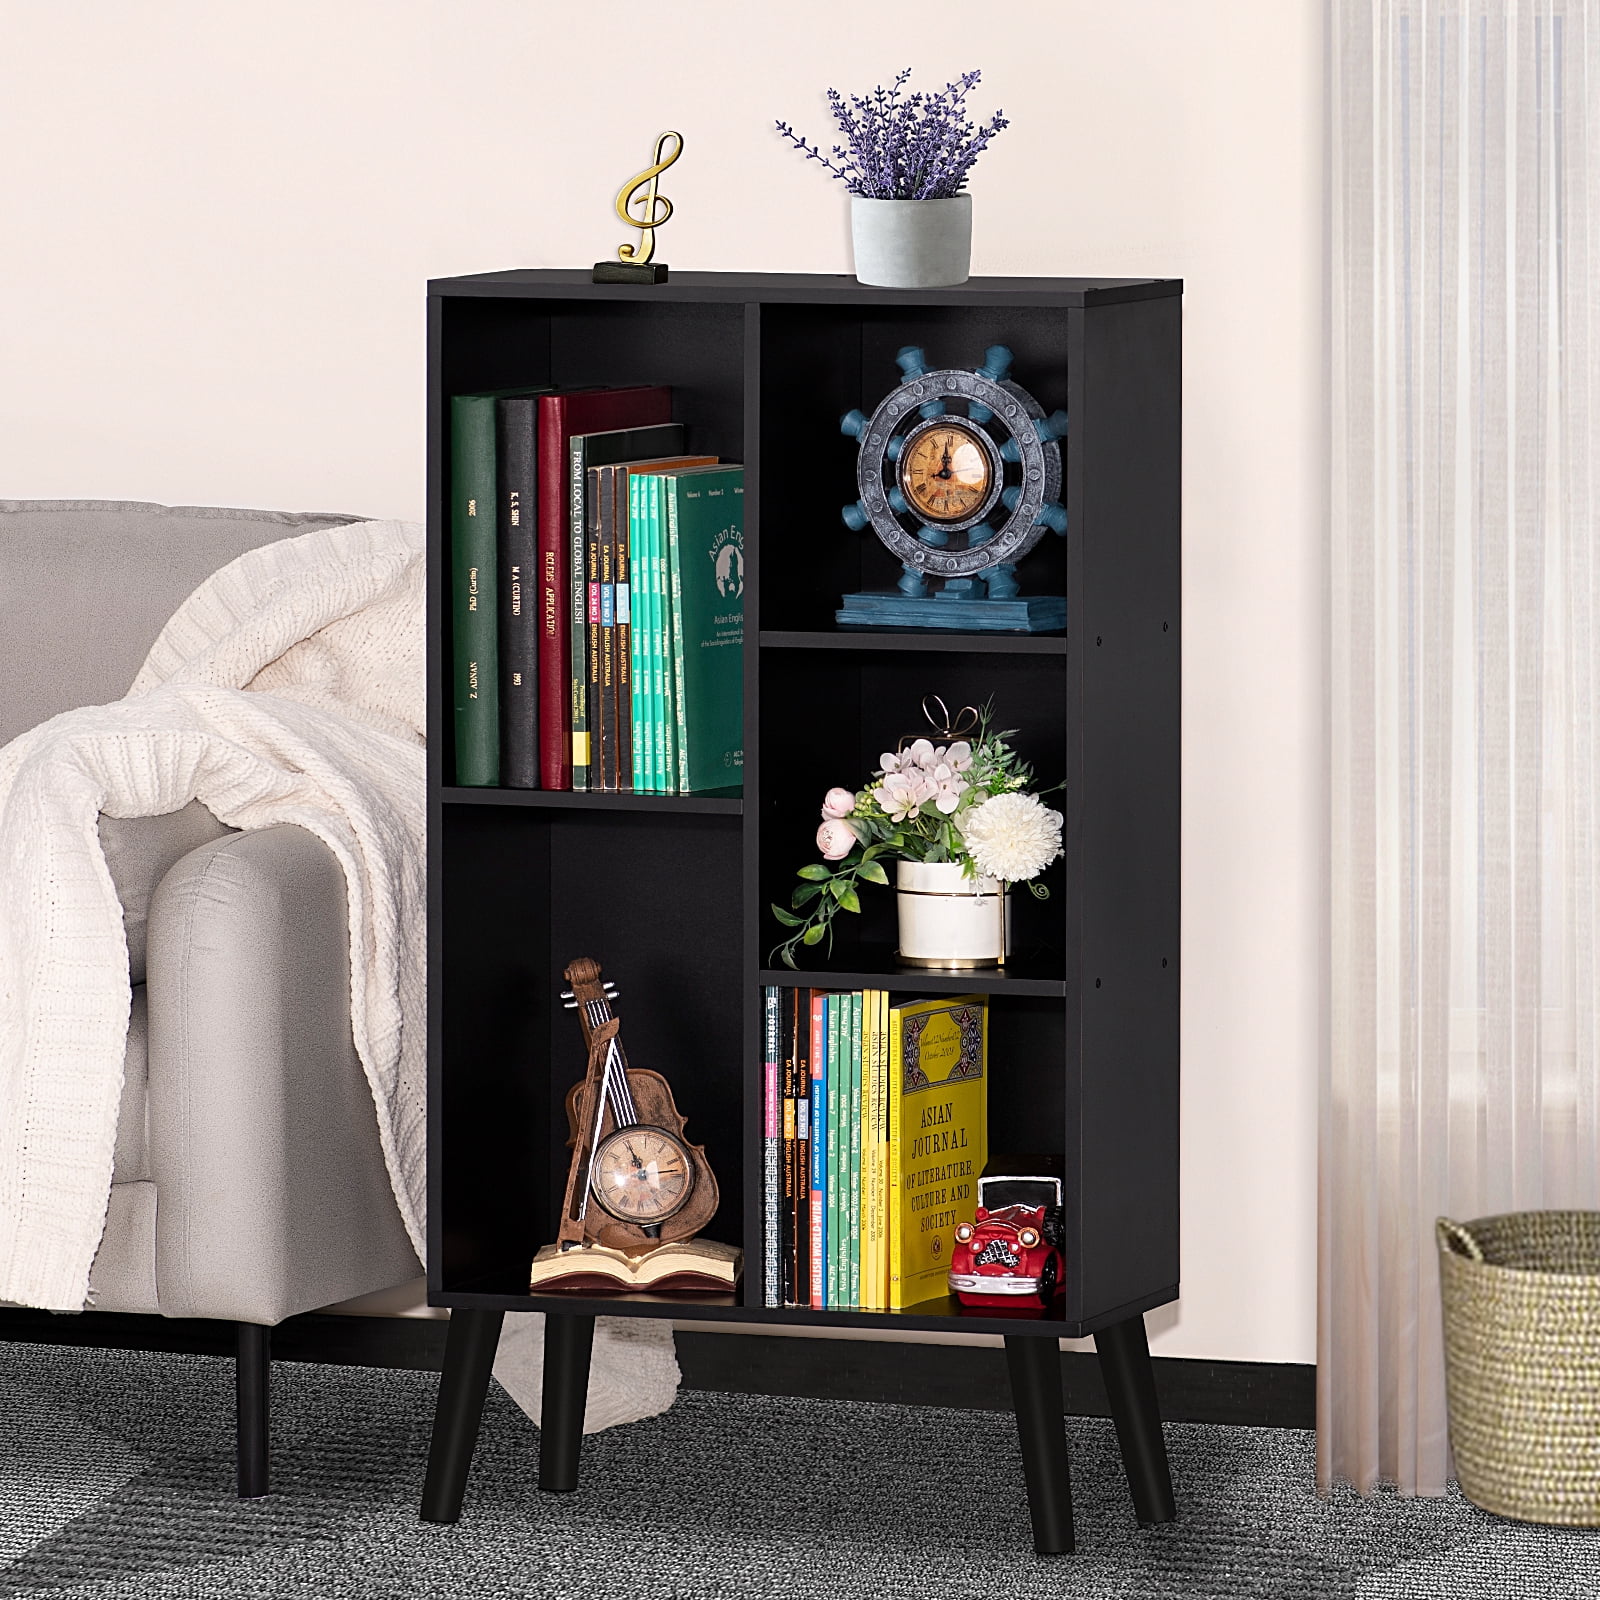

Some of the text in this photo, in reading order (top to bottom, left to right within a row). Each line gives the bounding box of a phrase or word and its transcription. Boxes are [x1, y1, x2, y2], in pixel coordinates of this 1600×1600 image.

[573, 451, 582, 480] FROM
[573, 484, 582, 517] LOCAL
[574, 520, 582, 533] TO
[574, 537, 582, 577] GLOBAL
[708, 528, 728, 562] Asian
[469, 568, 478, 611] PhD (Curtin)
[512, 582, 520, 616] (CURTIN)
[714, 615, 728, 624] Asian
[470, 662, 478, 689] ADNAN
[513, 673, 522, 686] 1993
[634, 721, 642, 754] Englishes
[829, 1030, 837, 1063] Englishes
[921, 1103, 953, 1128] ASIAN
[912, 1128, 968, 1159] JOURNAL
[906, 1160, 974, 1190] OF LITERATURE,
[911, 1184, 970, 1212] CULTURE AND
[920, 1210, 957, 1232] SOCIETY
[812, 1201, 821, 1296] ENGLISH WORLD-WIDE
